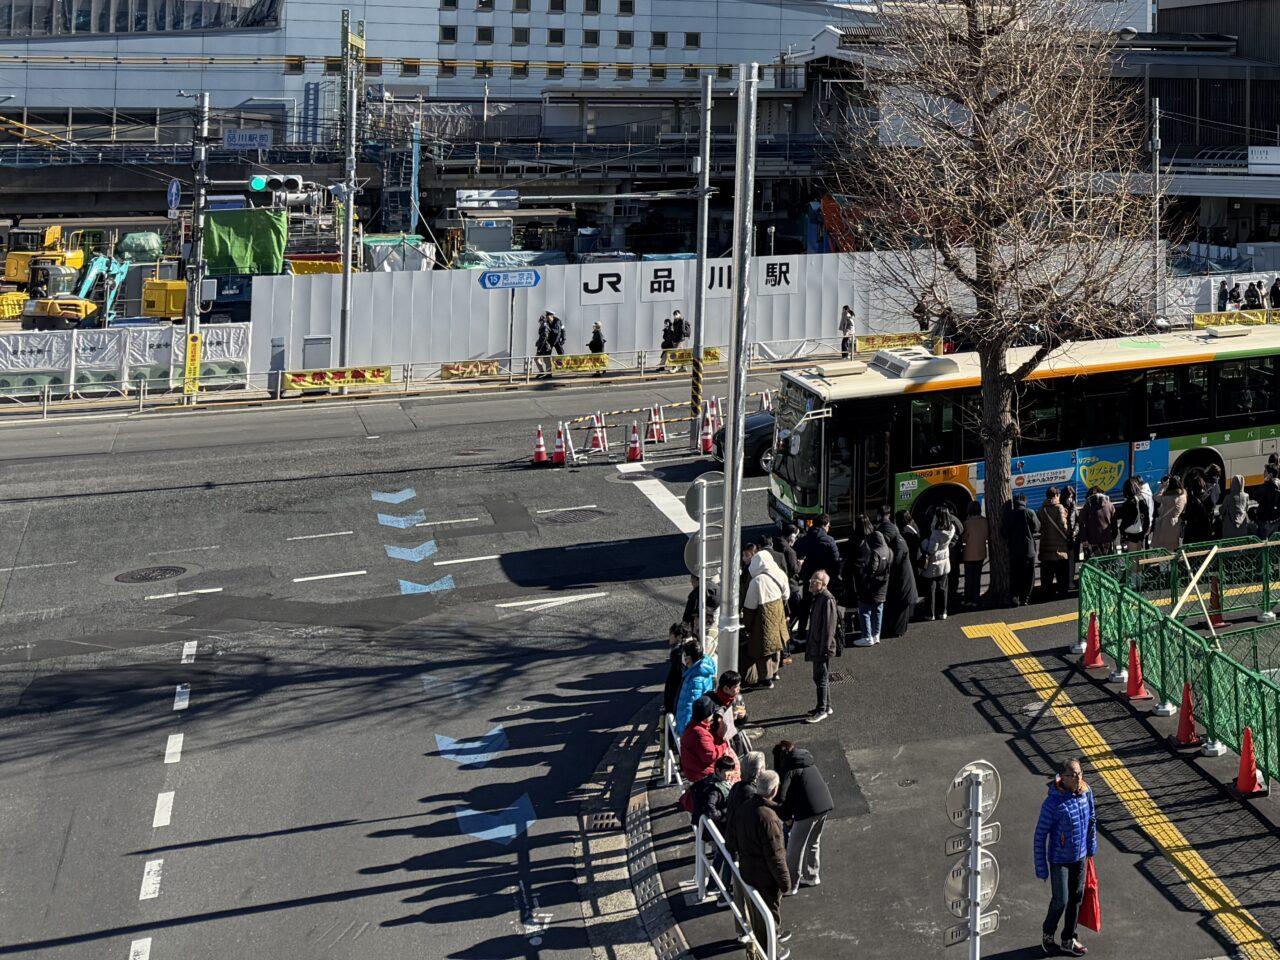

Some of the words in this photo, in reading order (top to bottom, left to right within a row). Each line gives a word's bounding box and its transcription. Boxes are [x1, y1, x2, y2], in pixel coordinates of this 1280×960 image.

[227, 134, 268, 143] 品川駅前
[583, 272, 622, 294] JR
